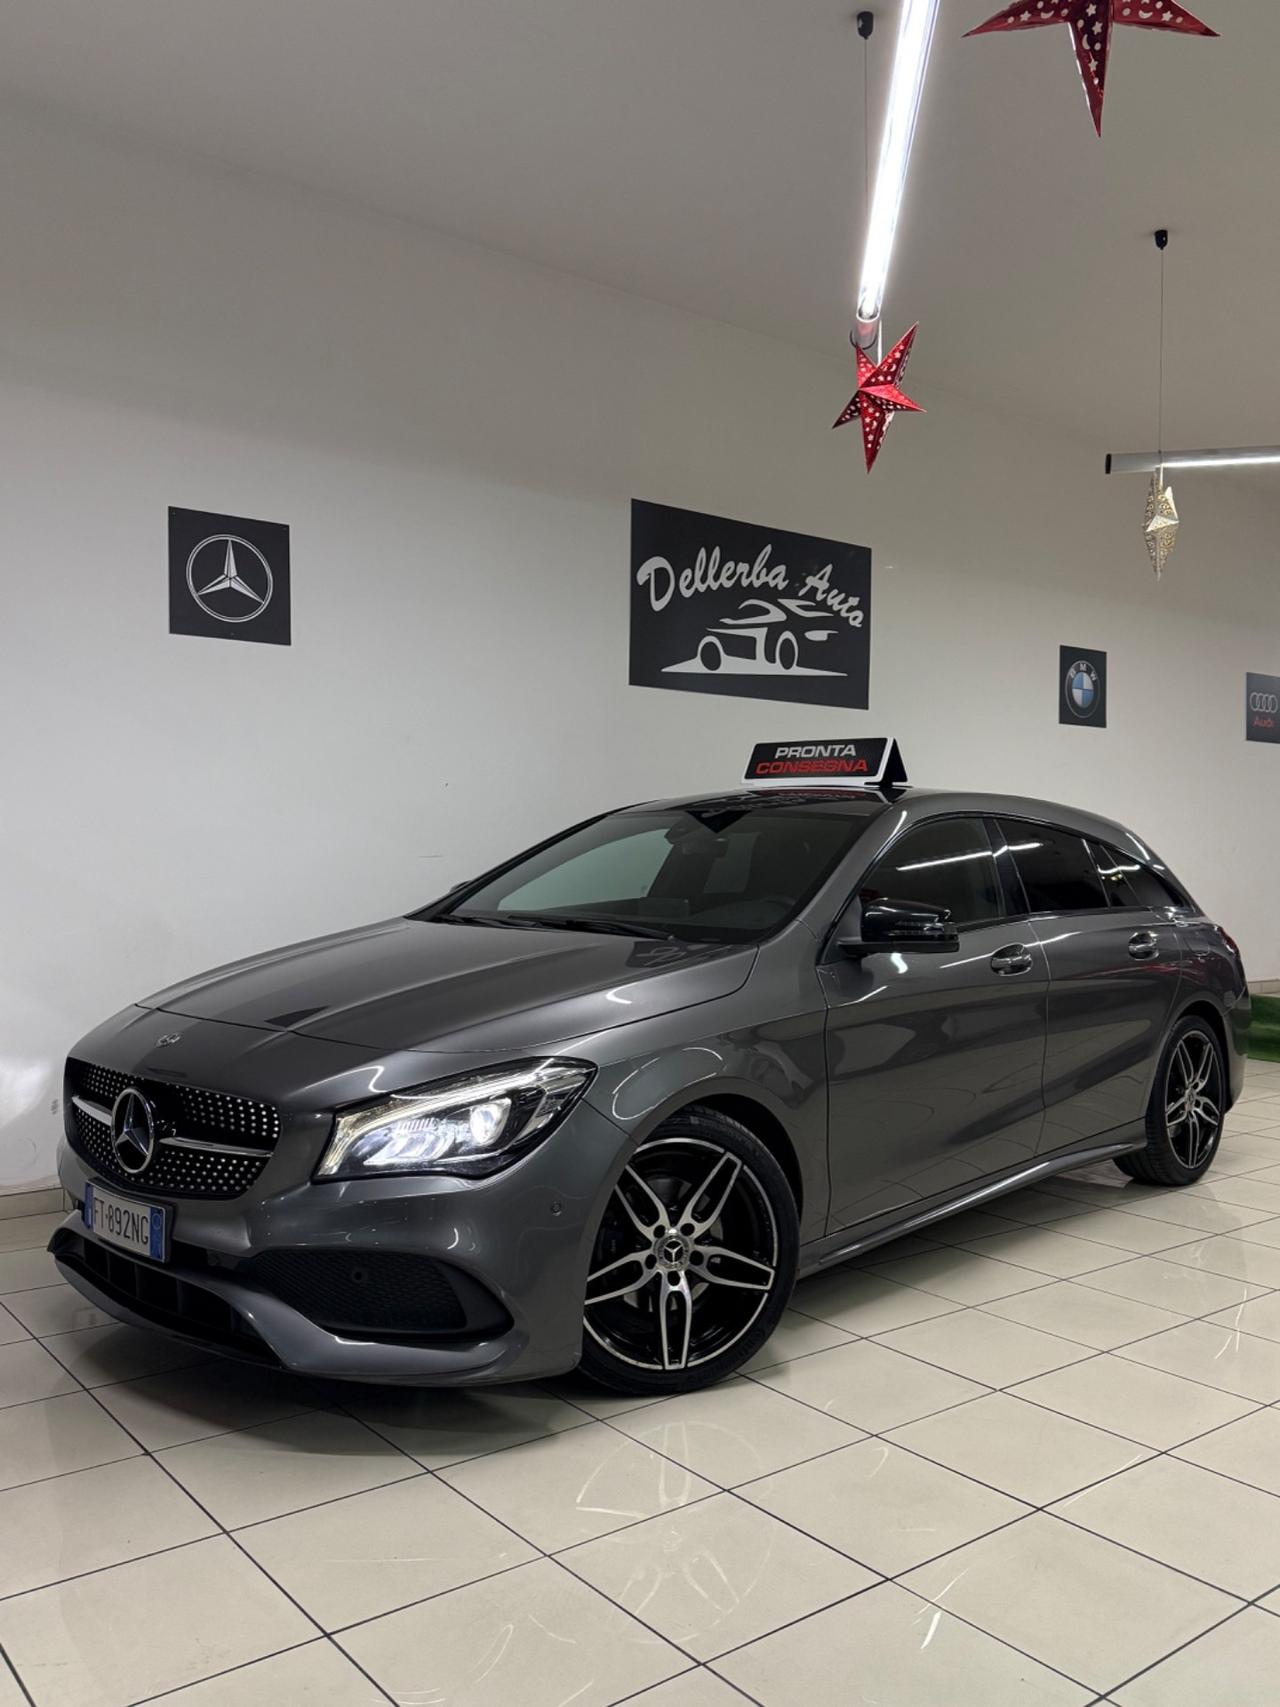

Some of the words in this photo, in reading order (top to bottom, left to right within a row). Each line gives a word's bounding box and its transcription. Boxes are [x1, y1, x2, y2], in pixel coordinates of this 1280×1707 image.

[636, 544, 789, 612] Dellerba
[798, 563, 865, 628] Auto
[1069, 663, 1098, 681] BMW
[774, 744, 857, 759] PRONTA
[755, 759, 869, 775] CONSEGNA
